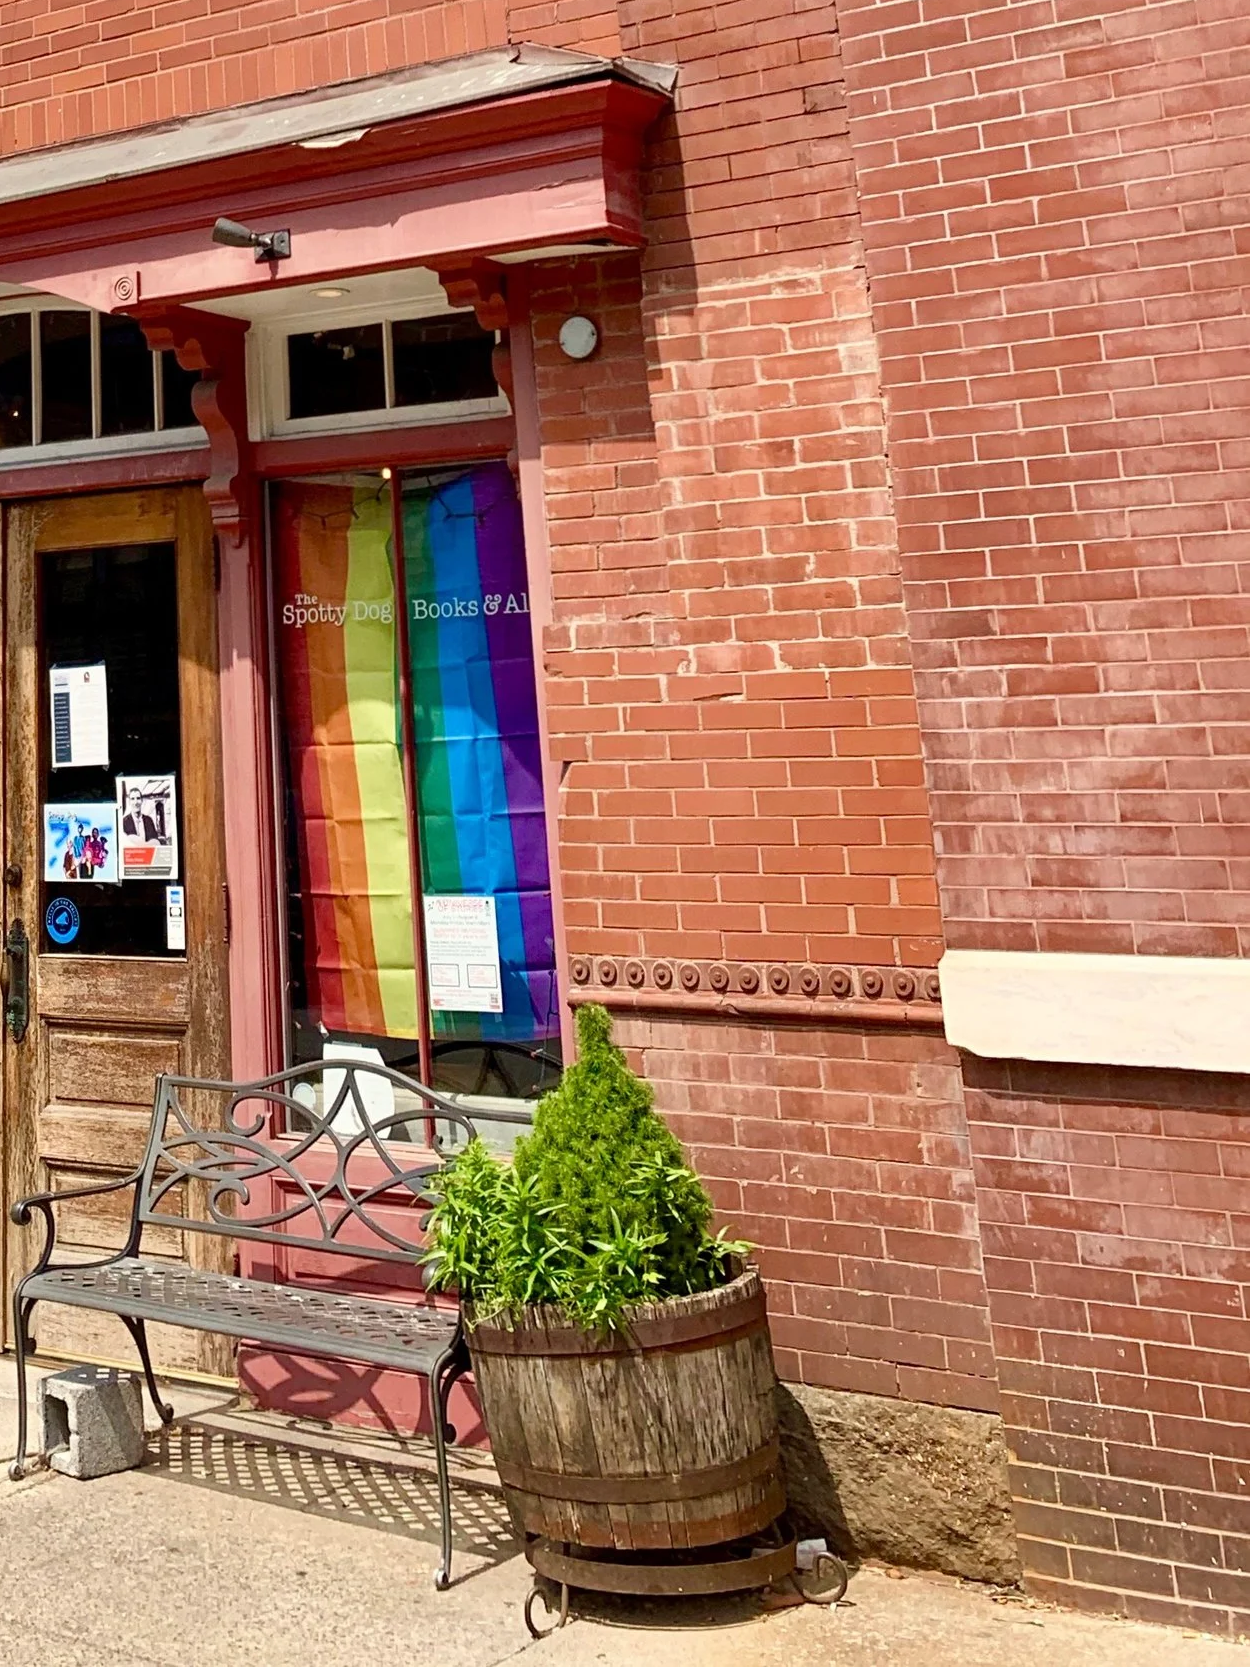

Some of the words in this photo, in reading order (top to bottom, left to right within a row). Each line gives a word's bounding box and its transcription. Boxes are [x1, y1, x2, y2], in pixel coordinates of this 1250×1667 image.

[282, 603, 347, 629] Spotty
[353, 600, 394, 624] Dog
[413, 597, 480, 621] Books
[482, 593, 503, 617] &
[503, 591, 531, 615] Al
[295, 593, 318, 606] The
